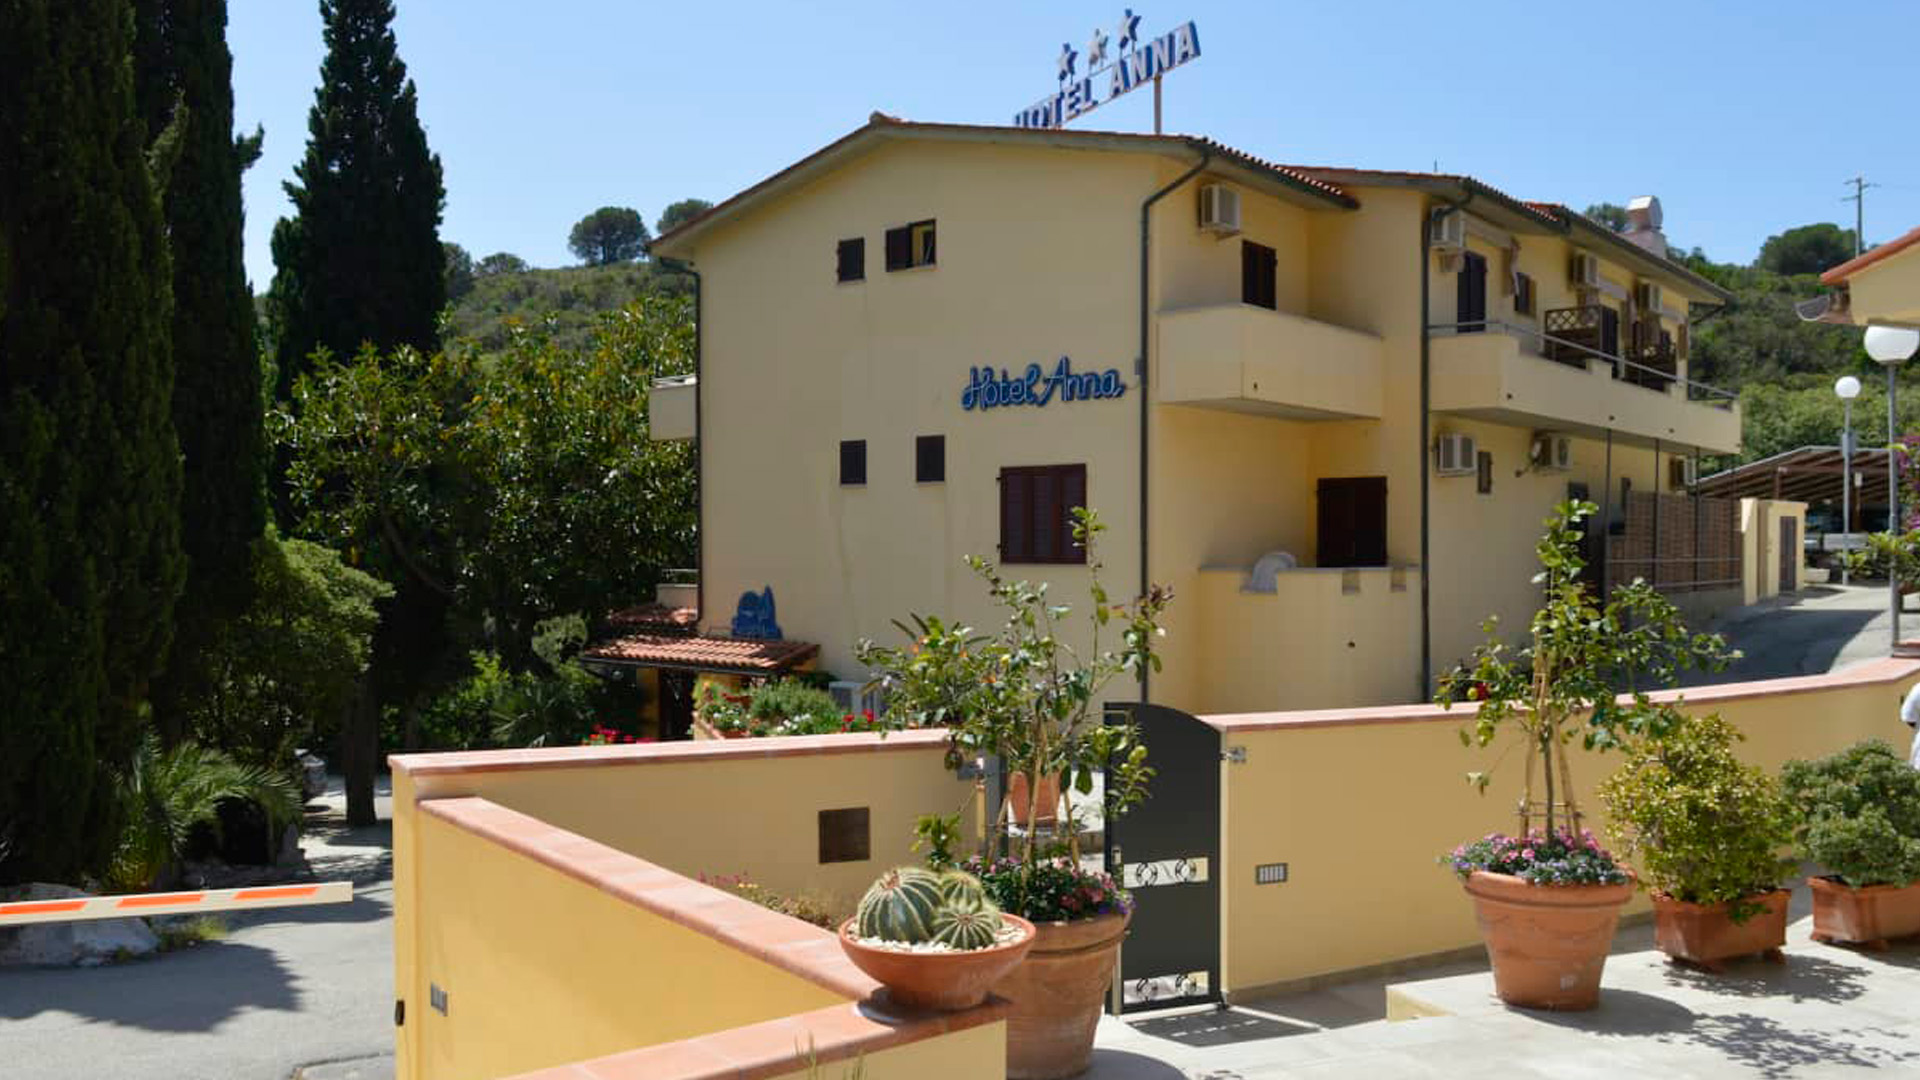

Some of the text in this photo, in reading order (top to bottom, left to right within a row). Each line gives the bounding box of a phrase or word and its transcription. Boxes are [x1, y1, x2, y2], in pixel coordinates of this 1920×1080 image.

[1109, 20, 1201, 99] ANNA
[962, 355, 1126, 411] Hotel Anna
